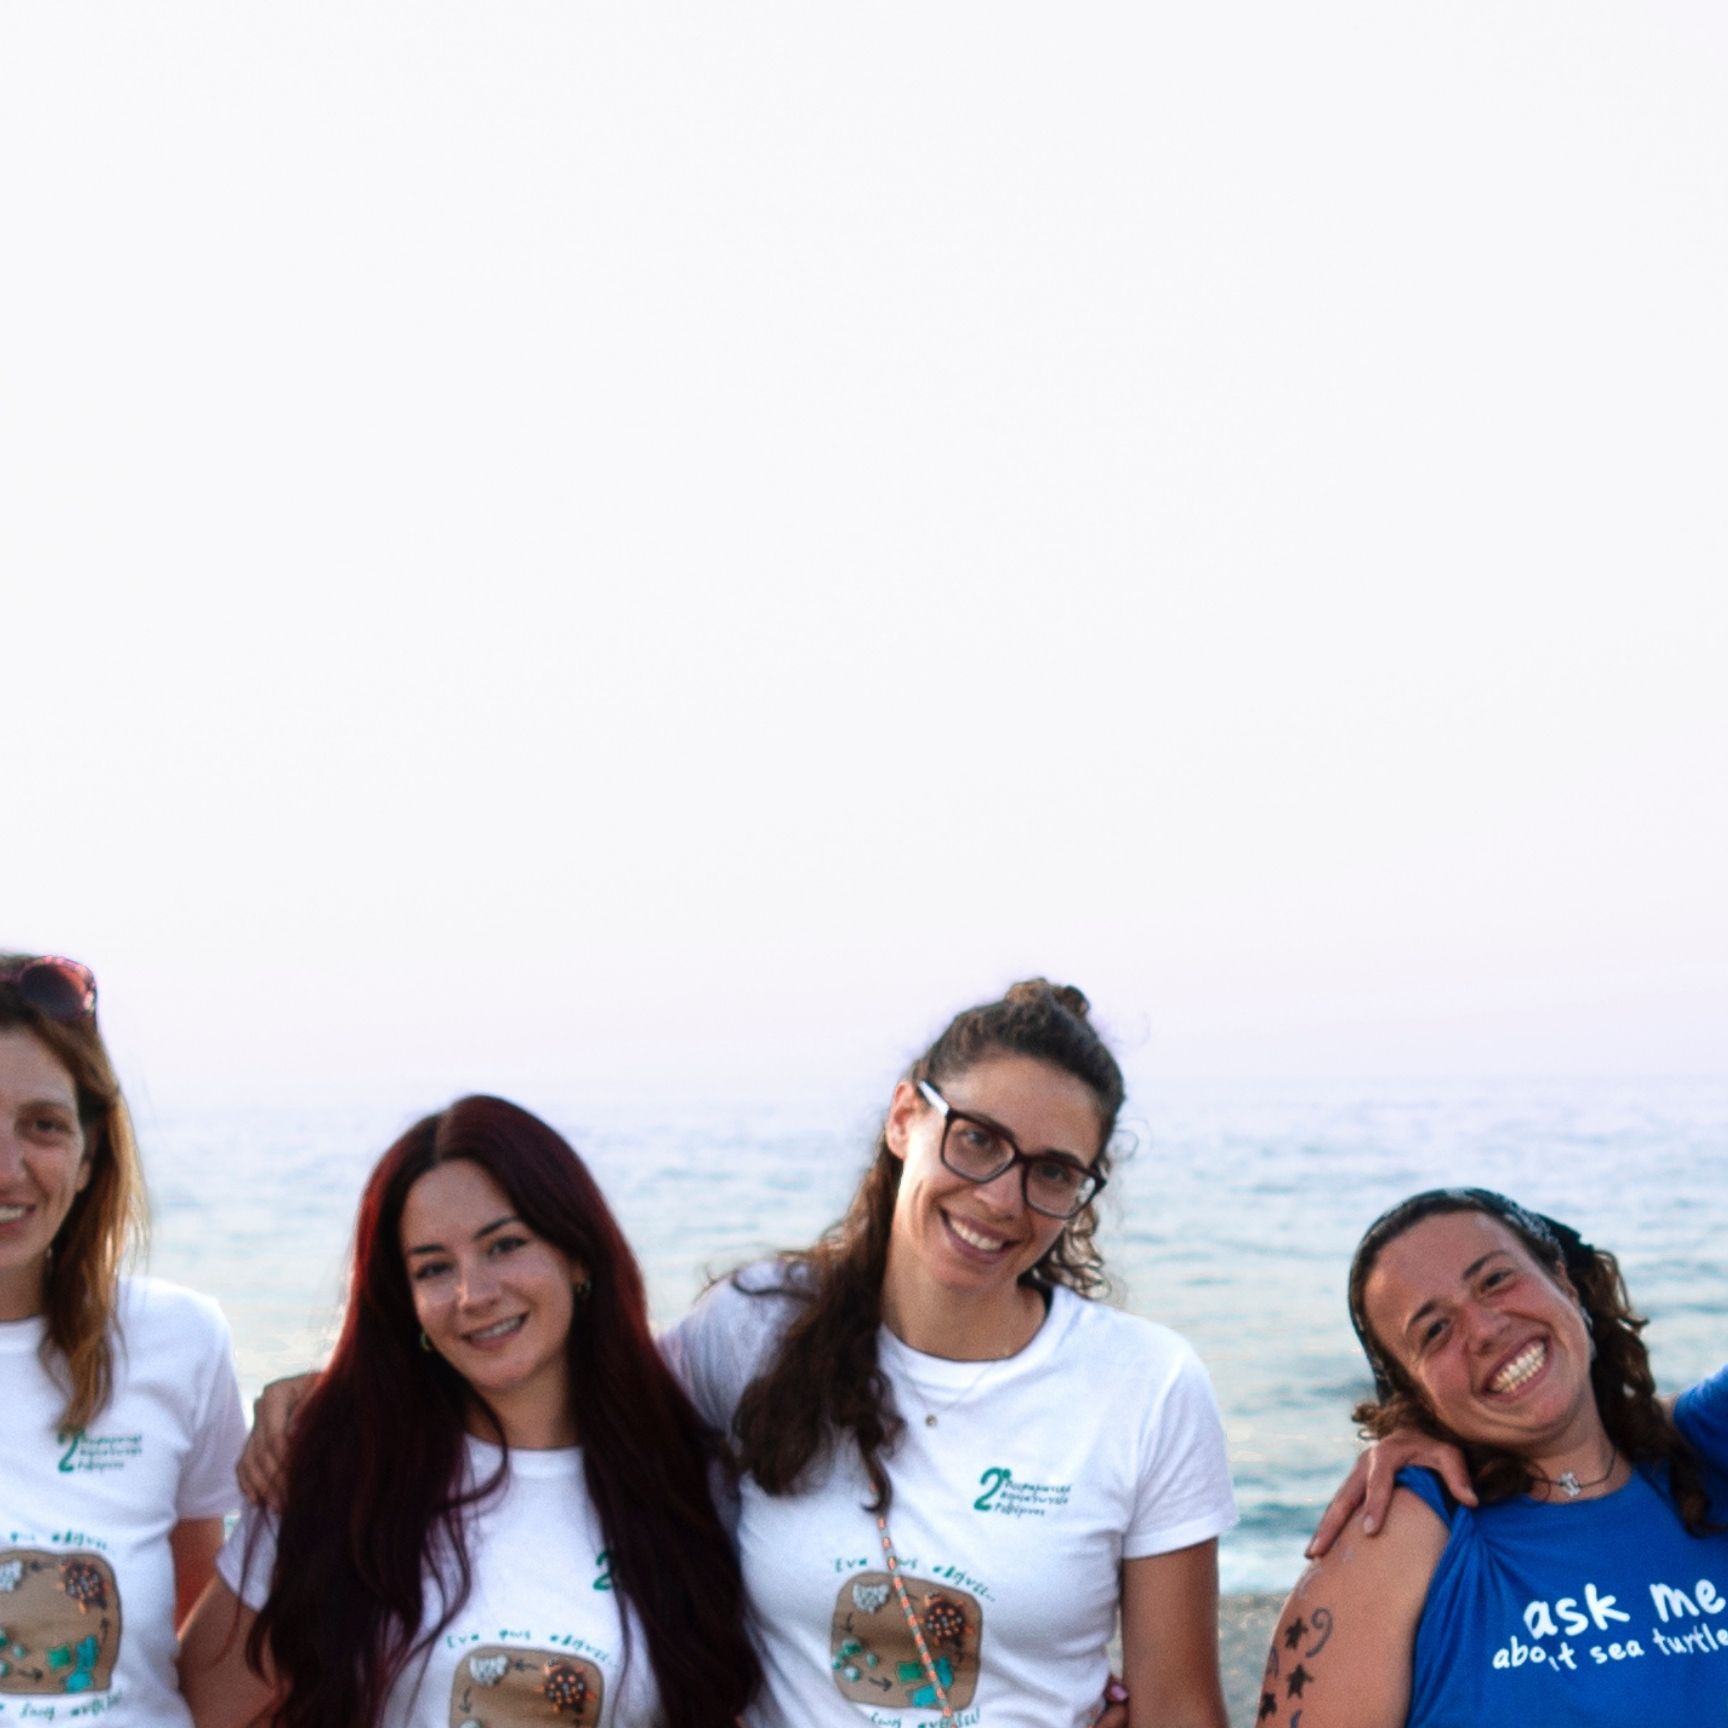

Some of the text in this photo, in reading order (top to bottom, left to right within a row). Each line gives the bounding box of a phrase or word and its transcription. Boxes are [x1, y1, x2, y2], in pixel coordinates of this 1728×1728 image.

[1523, 1579, 1726, 1640] ask me
[1590, 1640, 1645, 1664] sea
